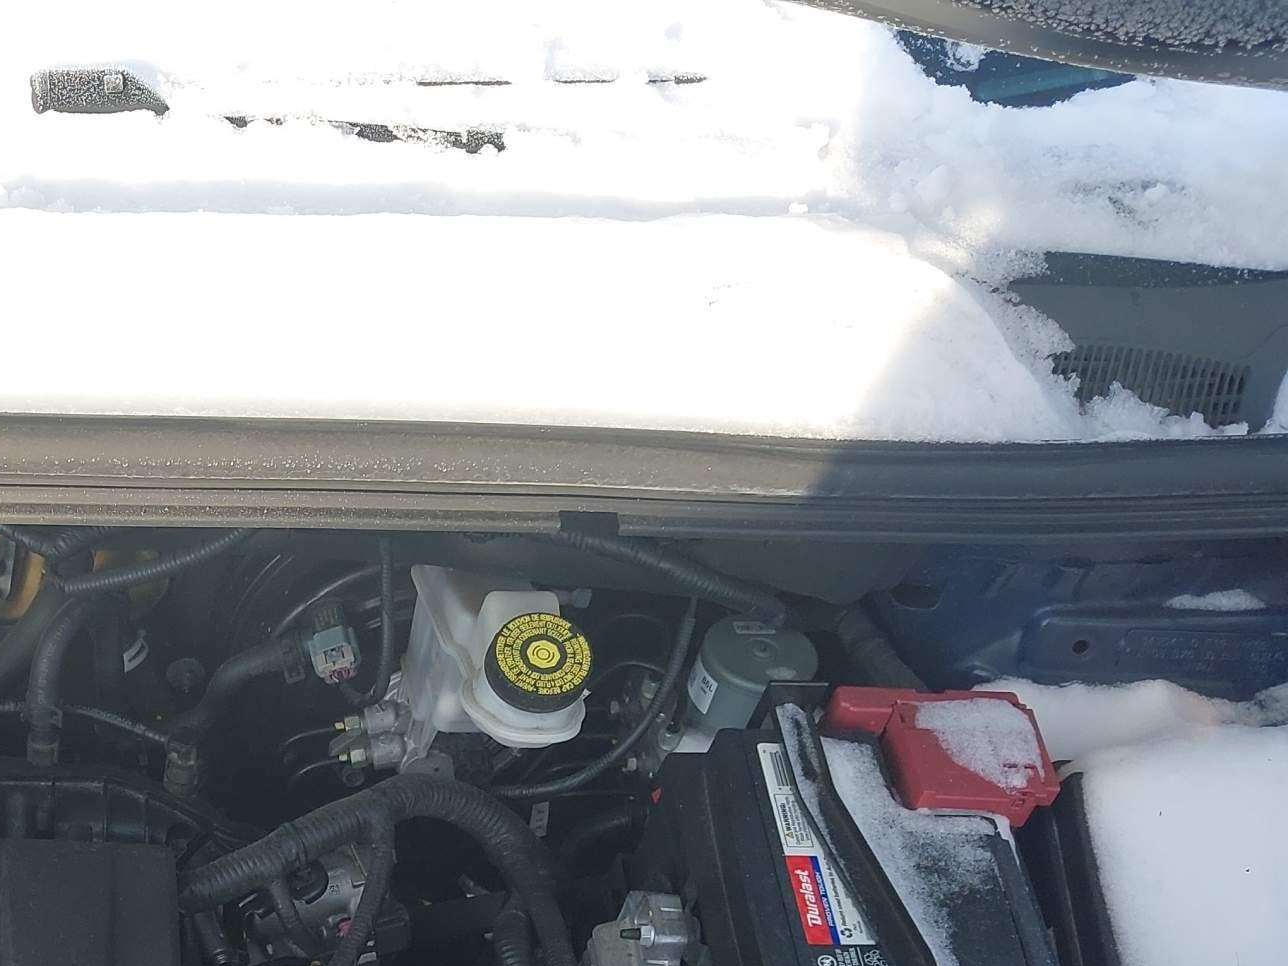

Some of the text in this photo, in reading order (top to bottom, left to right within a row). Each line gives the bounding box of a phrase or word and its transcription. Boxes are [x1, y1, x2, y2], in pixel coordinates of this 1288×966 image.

[794, 869, 822, 927] Duralast
[815, 871, 834, 927] PROVEN TOUGH
